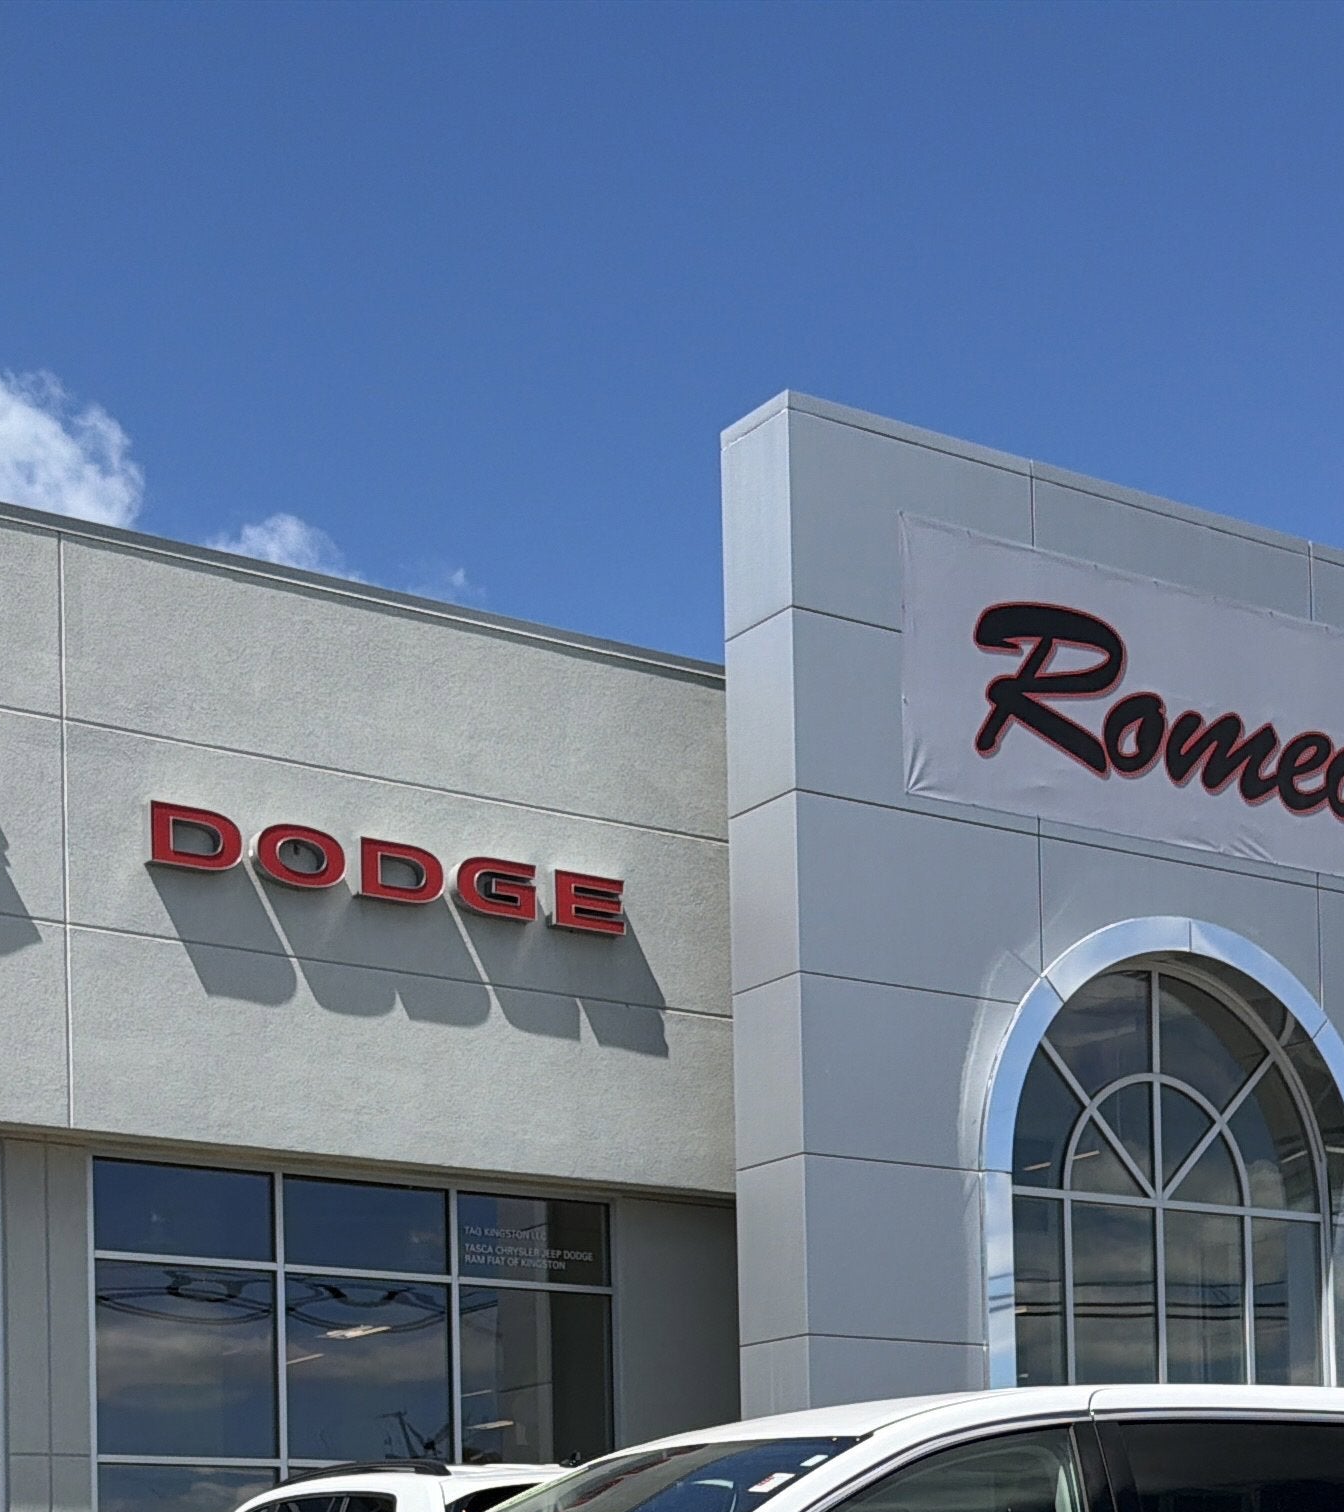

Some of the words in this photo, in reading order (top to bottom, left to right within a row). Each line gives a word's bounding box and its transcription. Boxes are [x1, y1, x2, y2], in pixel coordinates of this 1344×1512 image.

[146, 799, 627, 936] DODGE
[464, 1243, 494, 1255] TASCA
[495, 1245, 540, 1259] CHRYSLER
[542, 1249, 561, 1260] JEEP
[563, 1250, 594, 1262] DODGE
[521, 1260, 567, 1271] KINGSTON
